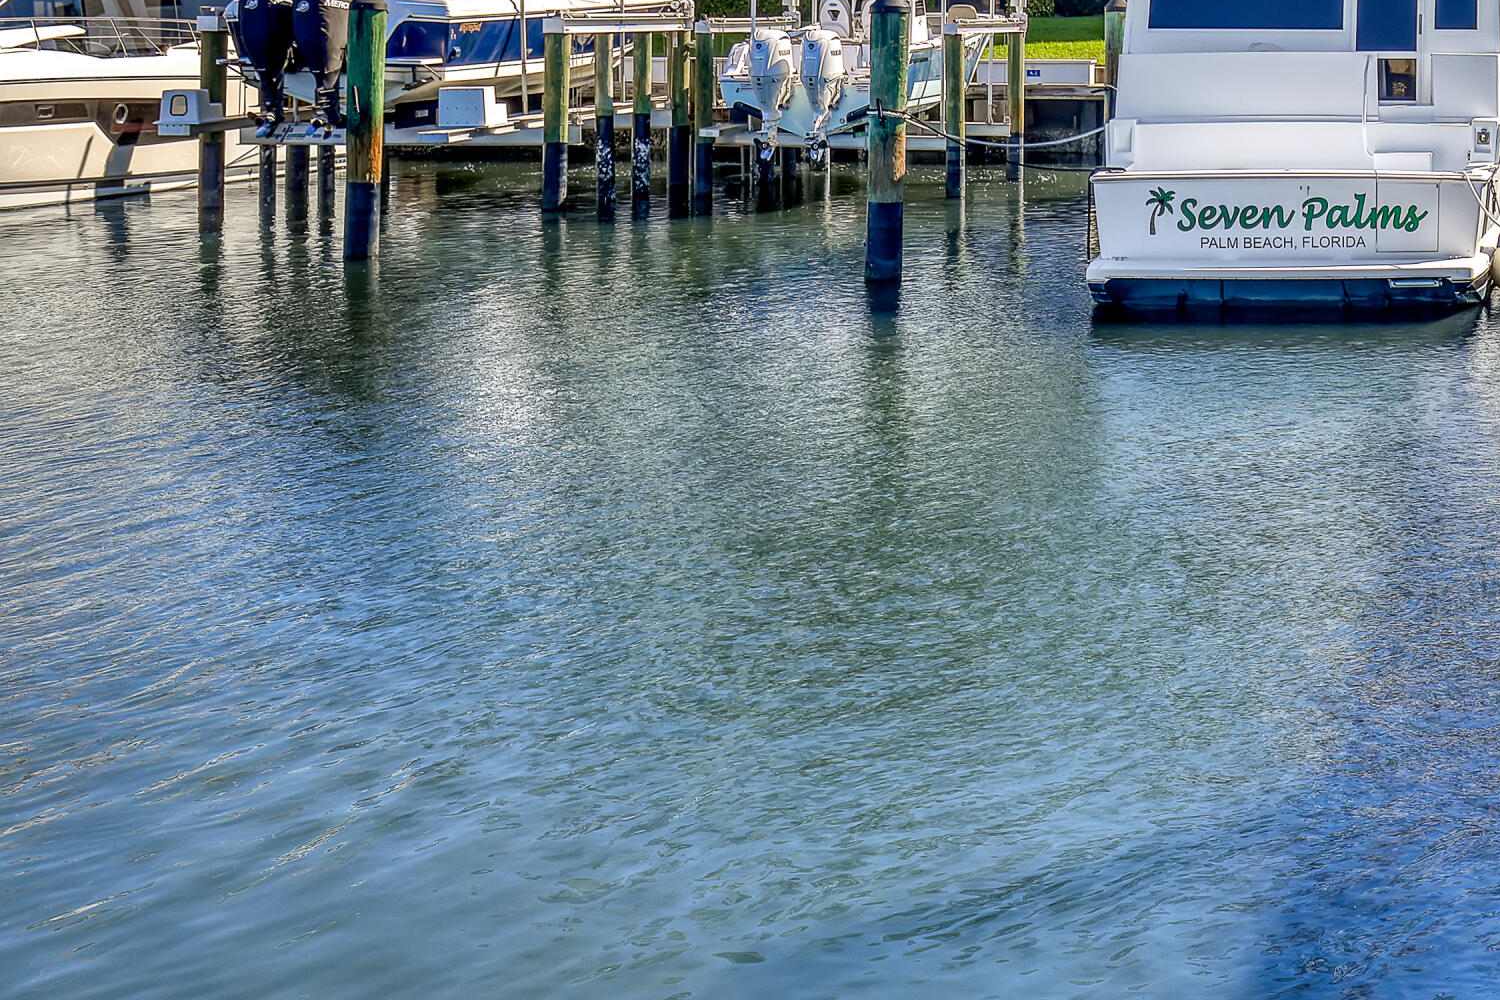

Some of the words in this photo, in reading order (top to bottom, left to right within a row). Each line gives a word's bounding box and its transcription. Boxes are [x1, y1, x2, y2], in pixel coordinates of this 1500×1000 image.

[323, 0, 349, 10] MERC
[1177, 198, 1296, 232] Seven
[1302, 193, 1429, 233] Palms
[1200, 237, 1239, 249] PALM
[1243, 237, 1297, 250] BEACH,
[1302, 236, 1367, 248] FLORIDA
